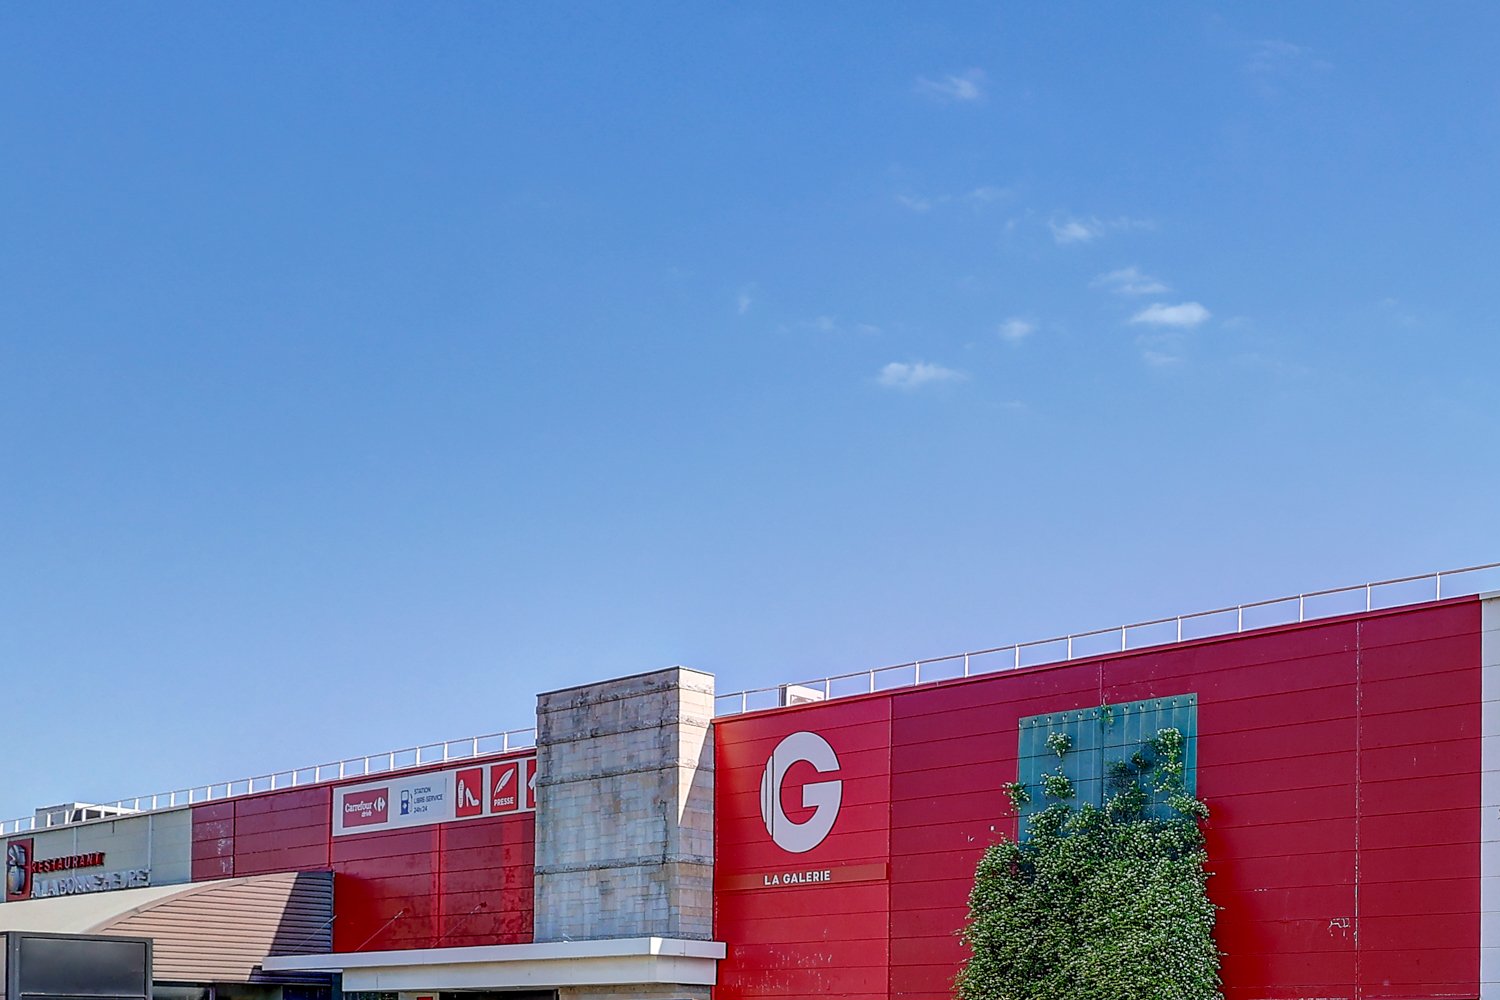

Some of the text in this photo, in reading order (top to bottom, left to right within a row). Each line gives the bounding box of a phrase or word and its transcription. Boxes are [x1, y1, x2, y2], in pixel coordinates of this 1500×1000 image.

[414, 786, 432, 795] STATION
[760, 731, 843, 853] G
[345, 800, 373, 813] Carrefour
[493, 796, 514, 807] PRESSE
[31, 852, 105, 874] RESTAURANT
[764, 871, 831, 885] LA GALERIE
